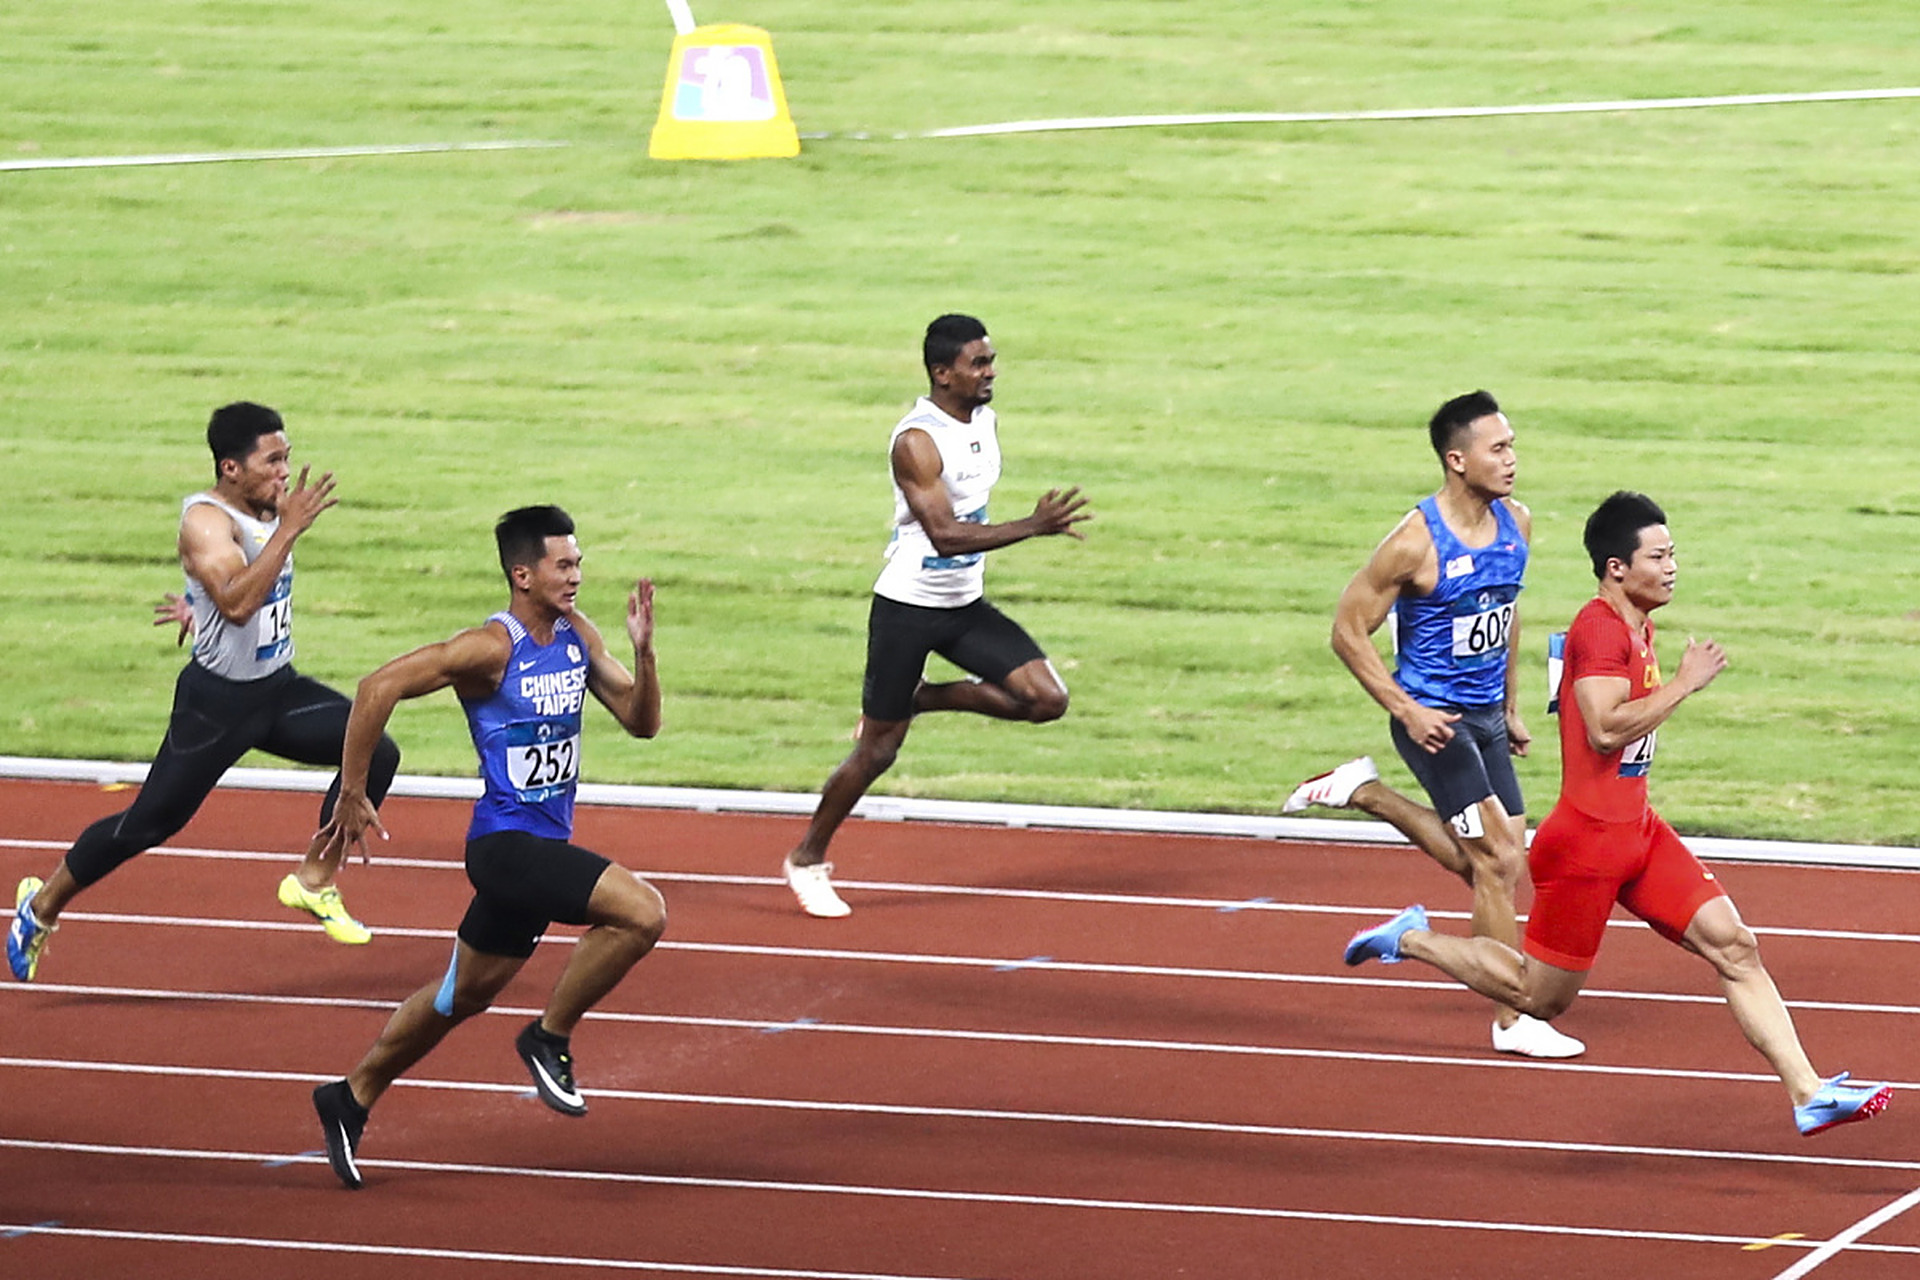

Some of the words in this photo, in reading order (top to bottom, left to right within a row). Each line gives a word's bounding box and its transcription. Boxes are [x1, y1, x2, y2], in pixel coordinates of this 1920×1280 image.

[269, 601, 292, 642] 14
[532, 691, 582, 717] TAIPEI
[525, 740, 574, 788] 252
[1459, 809, 1470, 835] 3
